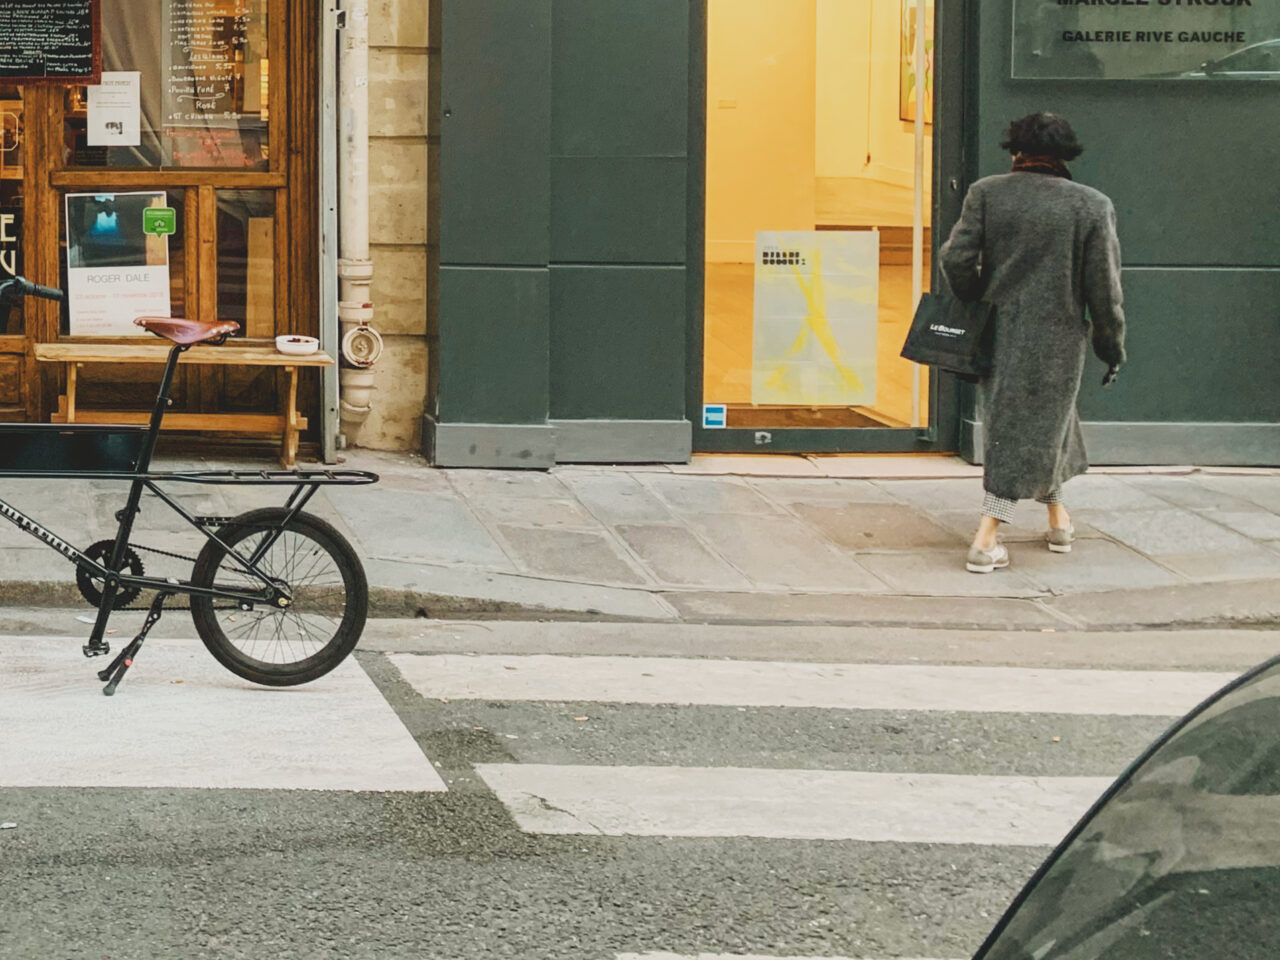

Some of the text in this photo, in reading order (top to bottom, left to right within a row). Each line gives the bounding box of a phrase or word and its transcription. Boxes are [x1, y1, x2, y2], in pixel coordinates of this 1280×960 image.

[1062, 30, 1246, 43] GALERIE RIVE GAUCHE
[86, 273, 151, 284] ROGER DALE
